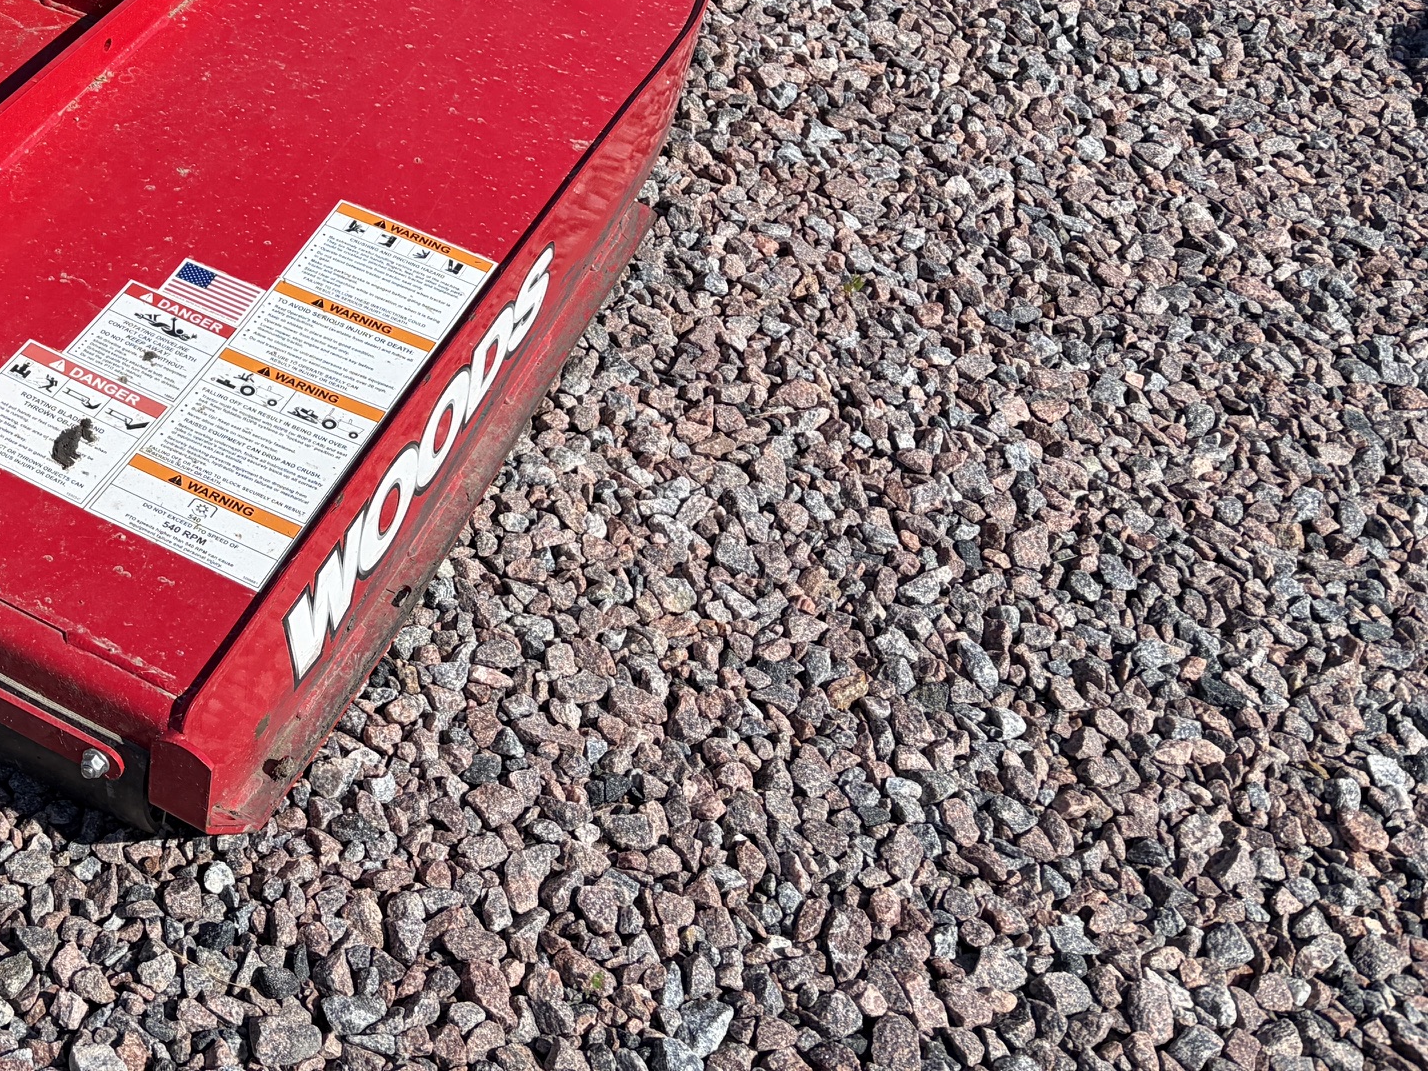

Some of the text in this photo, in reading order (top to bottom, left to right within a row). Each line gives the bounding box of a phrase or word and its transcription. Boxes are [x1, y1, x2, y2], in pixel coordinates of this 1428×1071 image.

[388, 225, 452, 254] WARNING
[156, 298, 225, 333] DANGER
[276, 297, 289, 305] TO
[287, 301, 312, 314] AVOID
[310, 310, 345, 328] SERIOUS
[344, 324, 374, 339] INJURY
[372, 335, 386, 344] OR
[327, 303, 393, 334] WARNING
[68, 366, 142, 406] DANGER
[273, 371, 340, 404] WARNING
[282, 242, 555, 691] WOODS
[185, 481, 256, 517] WARNING
[161, 520, 207, 545] 540 RPM
